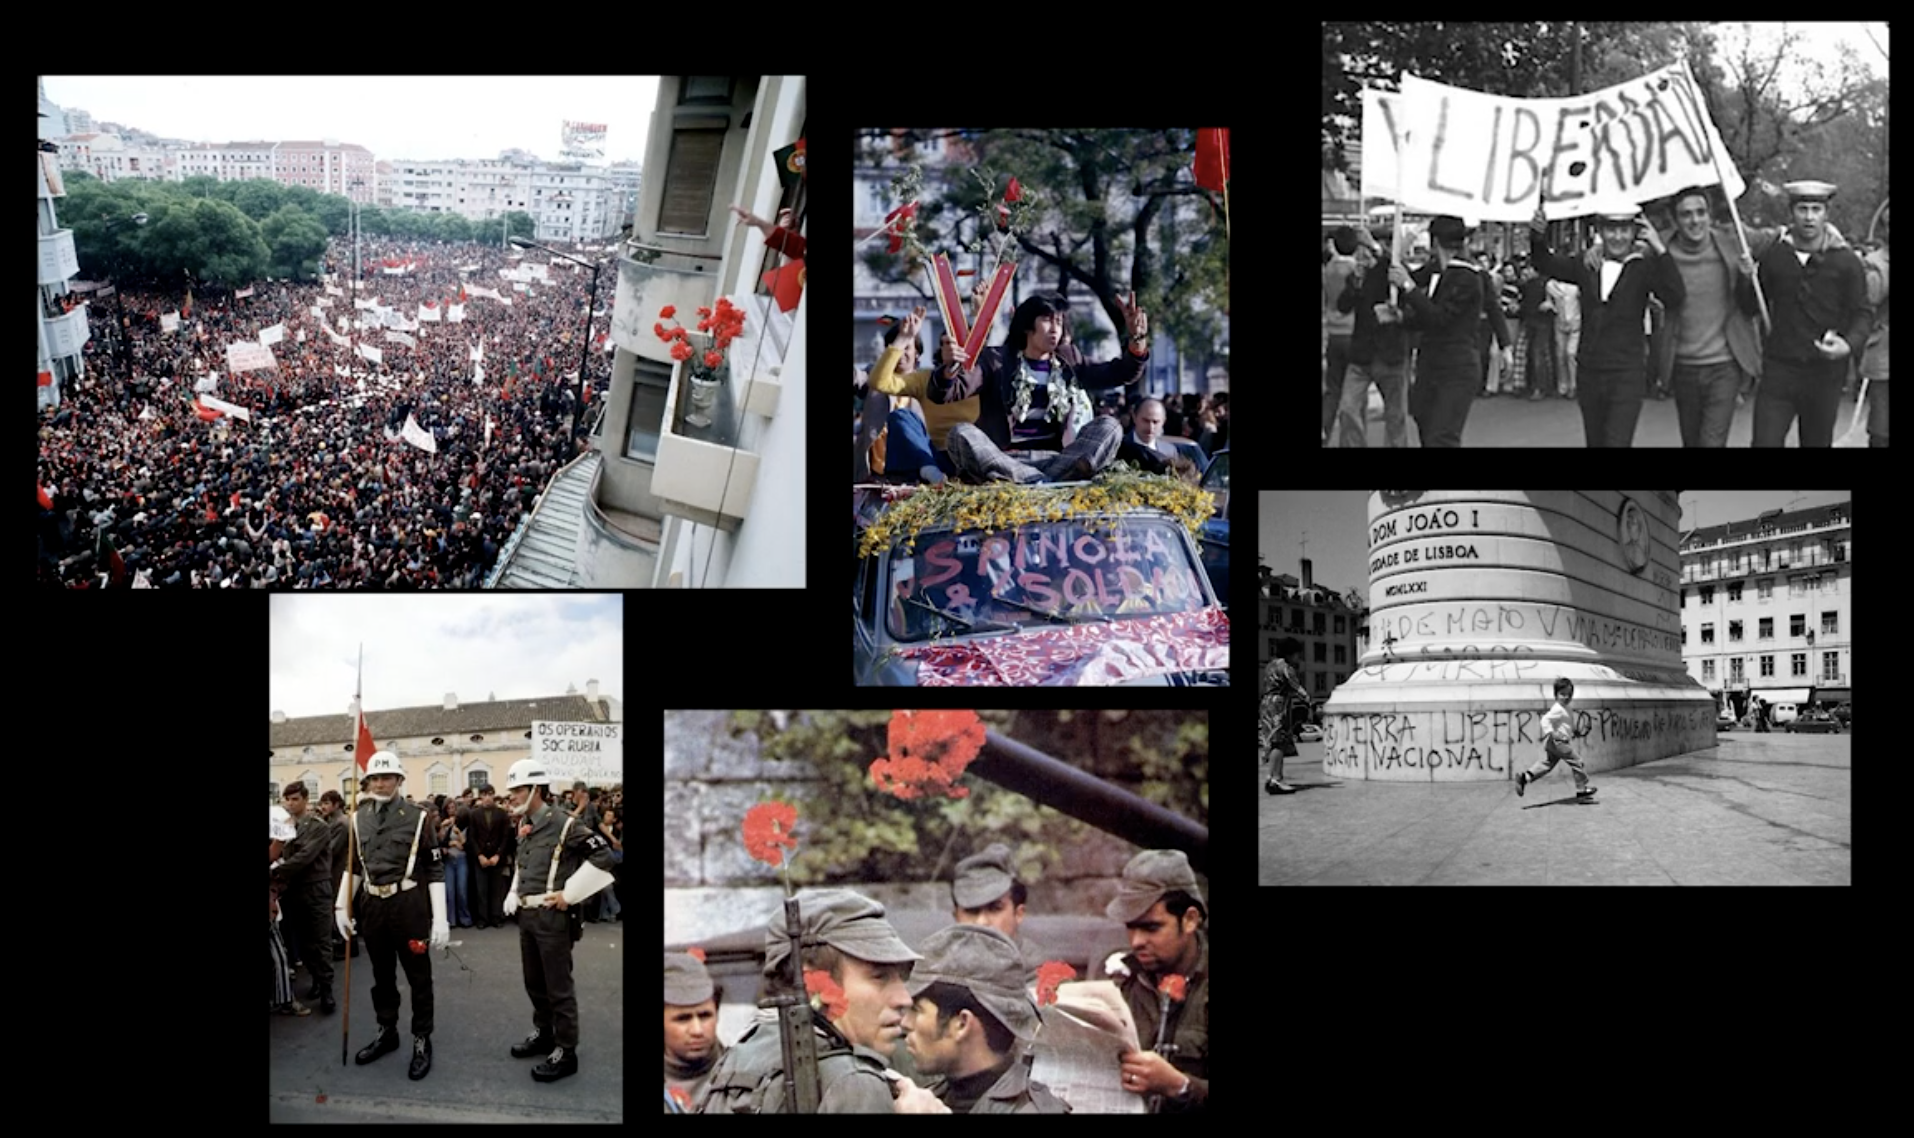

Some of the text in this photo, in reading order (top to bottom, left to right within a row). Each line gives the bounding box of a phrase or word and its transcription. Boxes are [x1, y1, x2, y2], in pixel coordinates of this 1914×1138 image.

[1405, 507, 1460, 533] JOÃO
[1471, 509, 1479, 529] I
[1403, 547, 1420, 563] DE
[1425, 544, 1480, 561] LISBOA
[538, 723, 554, 736] OS
[1341, 713, 1417, 745] TERRA
[374, 759, 390, 769] PM
[1370, 740, 1504, 772] NACIONAL
